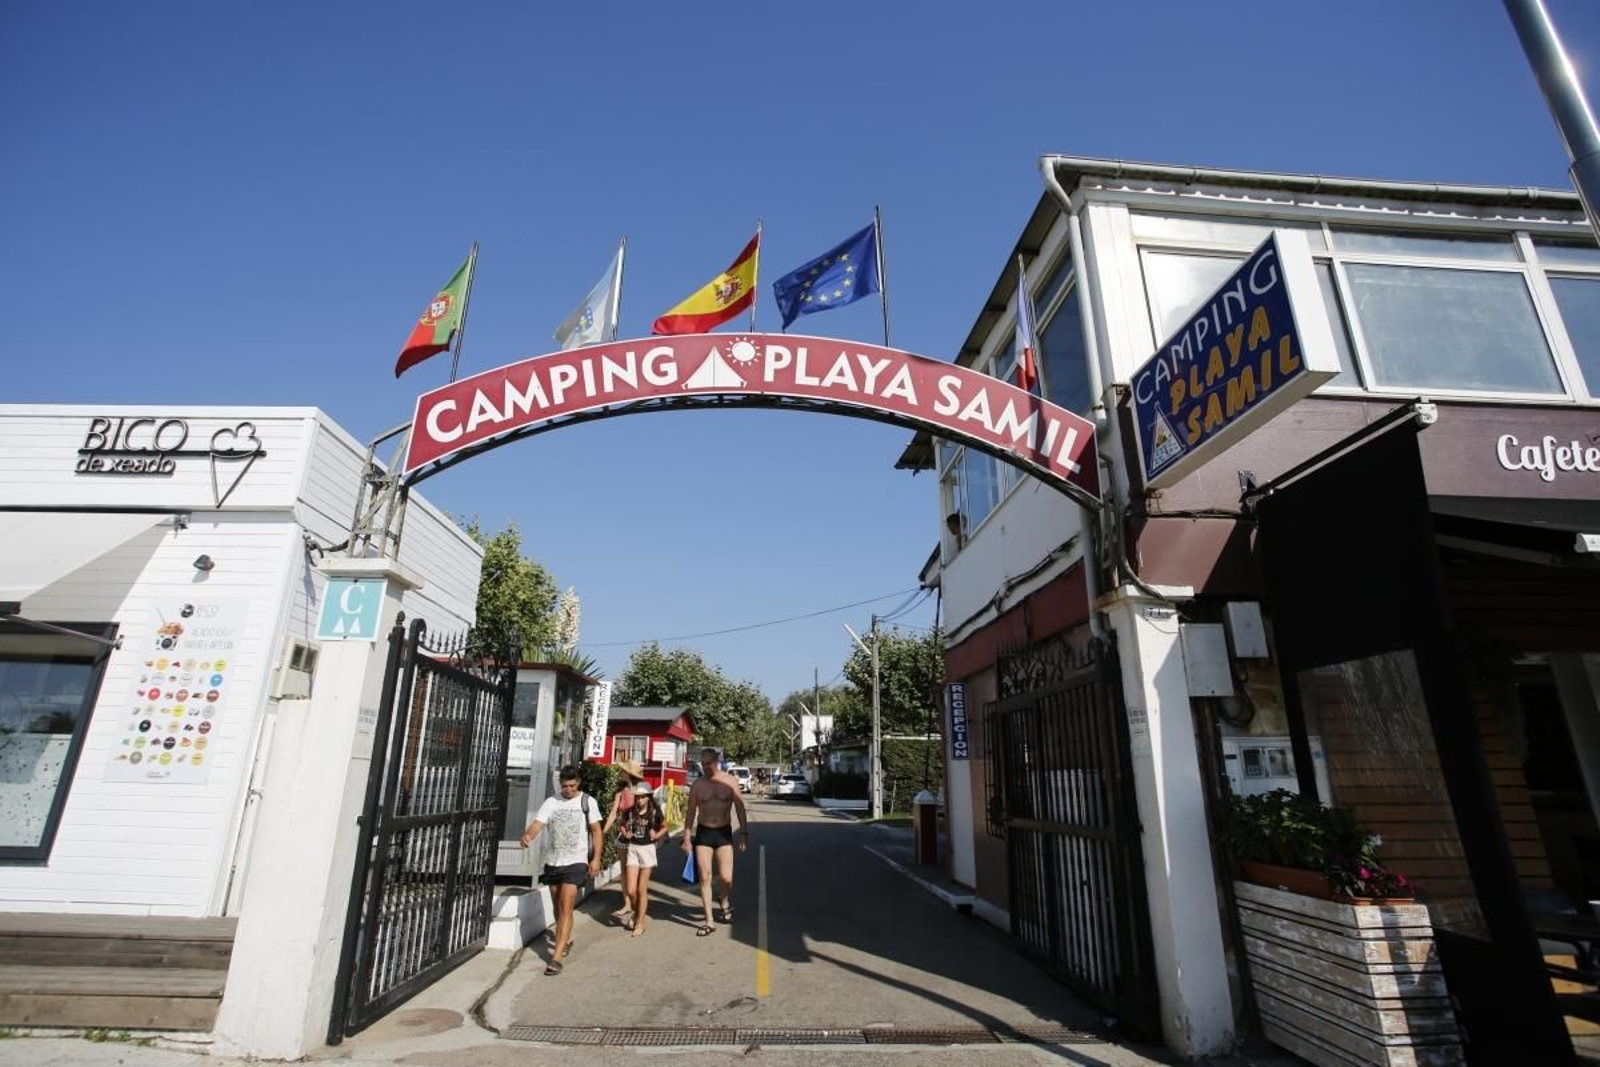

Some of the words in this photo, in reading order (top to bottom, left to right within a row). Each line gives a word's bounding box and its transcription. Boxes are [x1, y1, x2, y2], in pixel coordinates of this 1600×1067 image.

[1136, 249, 1278, 405] CAMPING
[1169, 305, 1271, 416] PLAYA
[425, 346, 679, 444] CAMPING
[764, 344, 919, 406] PLAYA
[933, 374, 1082, 474] SAMIL
[1186, 334, 1300, 446] SAMIL
[76, 452, 104, 473] de
[110, 452, 177, 474] xeado
[84, 416, 189, 452] BICO
[341, 584, 365, 615] C
[592, 684, 608, 750] RECEPCION
[951, 685, 968, 758] RECEPCION
